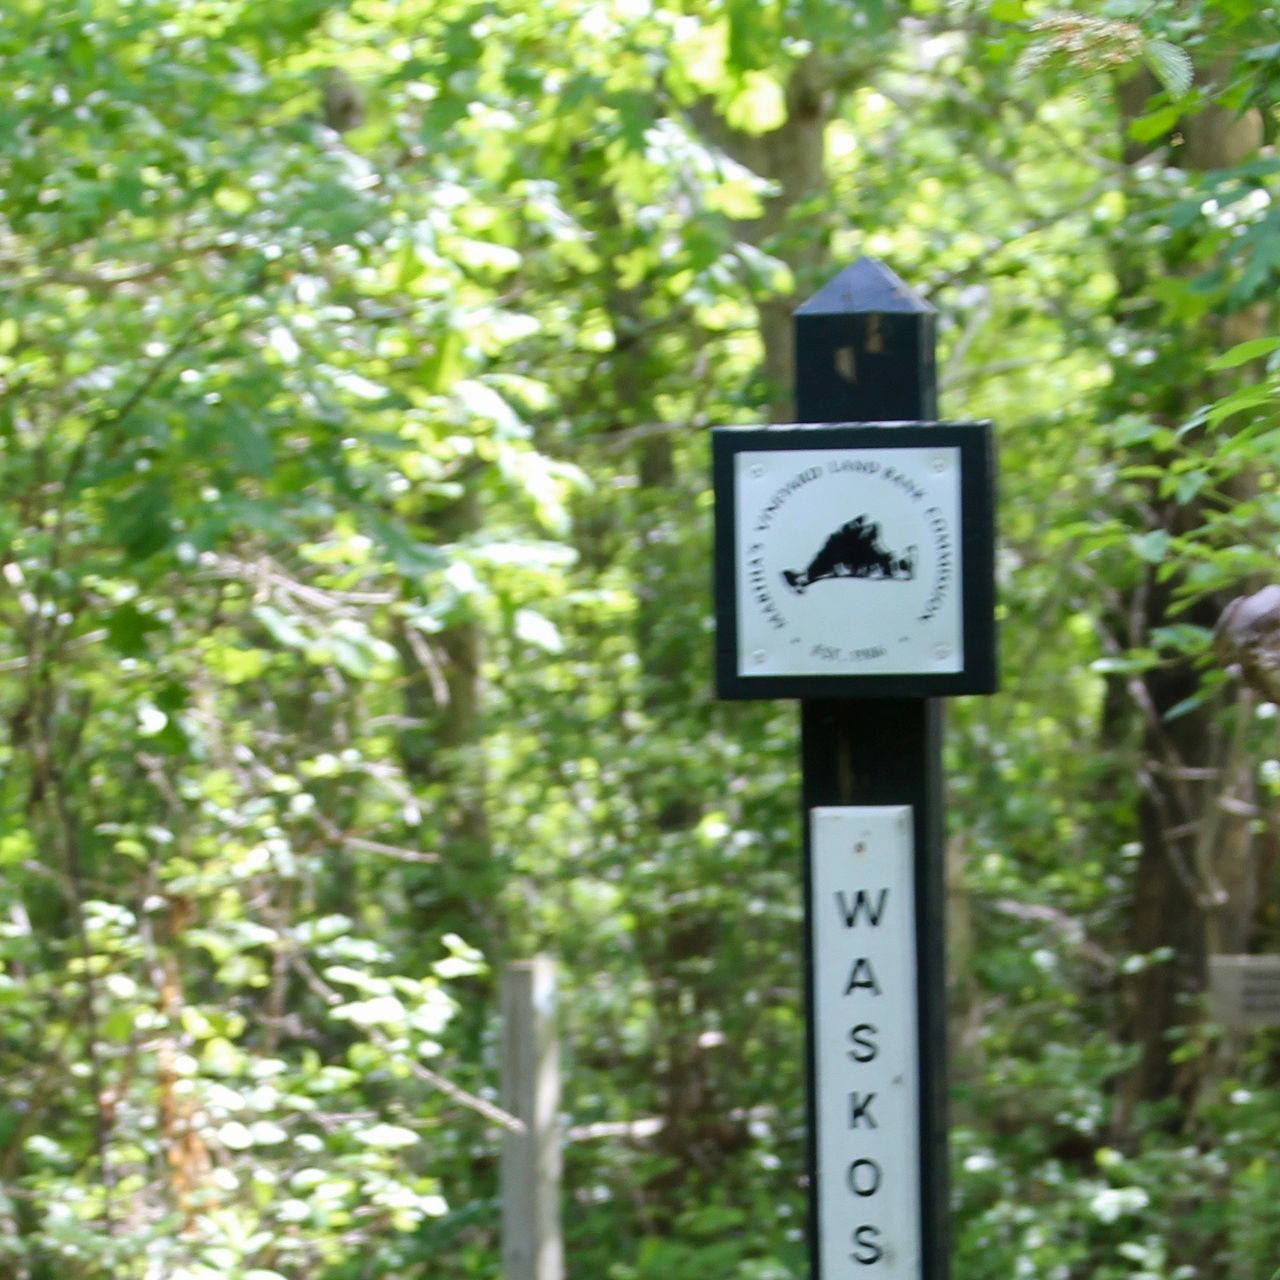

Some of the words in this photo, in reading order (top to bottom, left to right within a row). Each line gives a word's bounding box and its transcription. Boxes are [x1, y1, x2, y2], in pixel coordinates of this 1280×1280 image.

[755, 464, 824, 532] VINEYARD
[828, 458, 882, 475] LAND
[881, 467, 927, 502] BANK
[917, 505, 952, 623] COMMISSION
